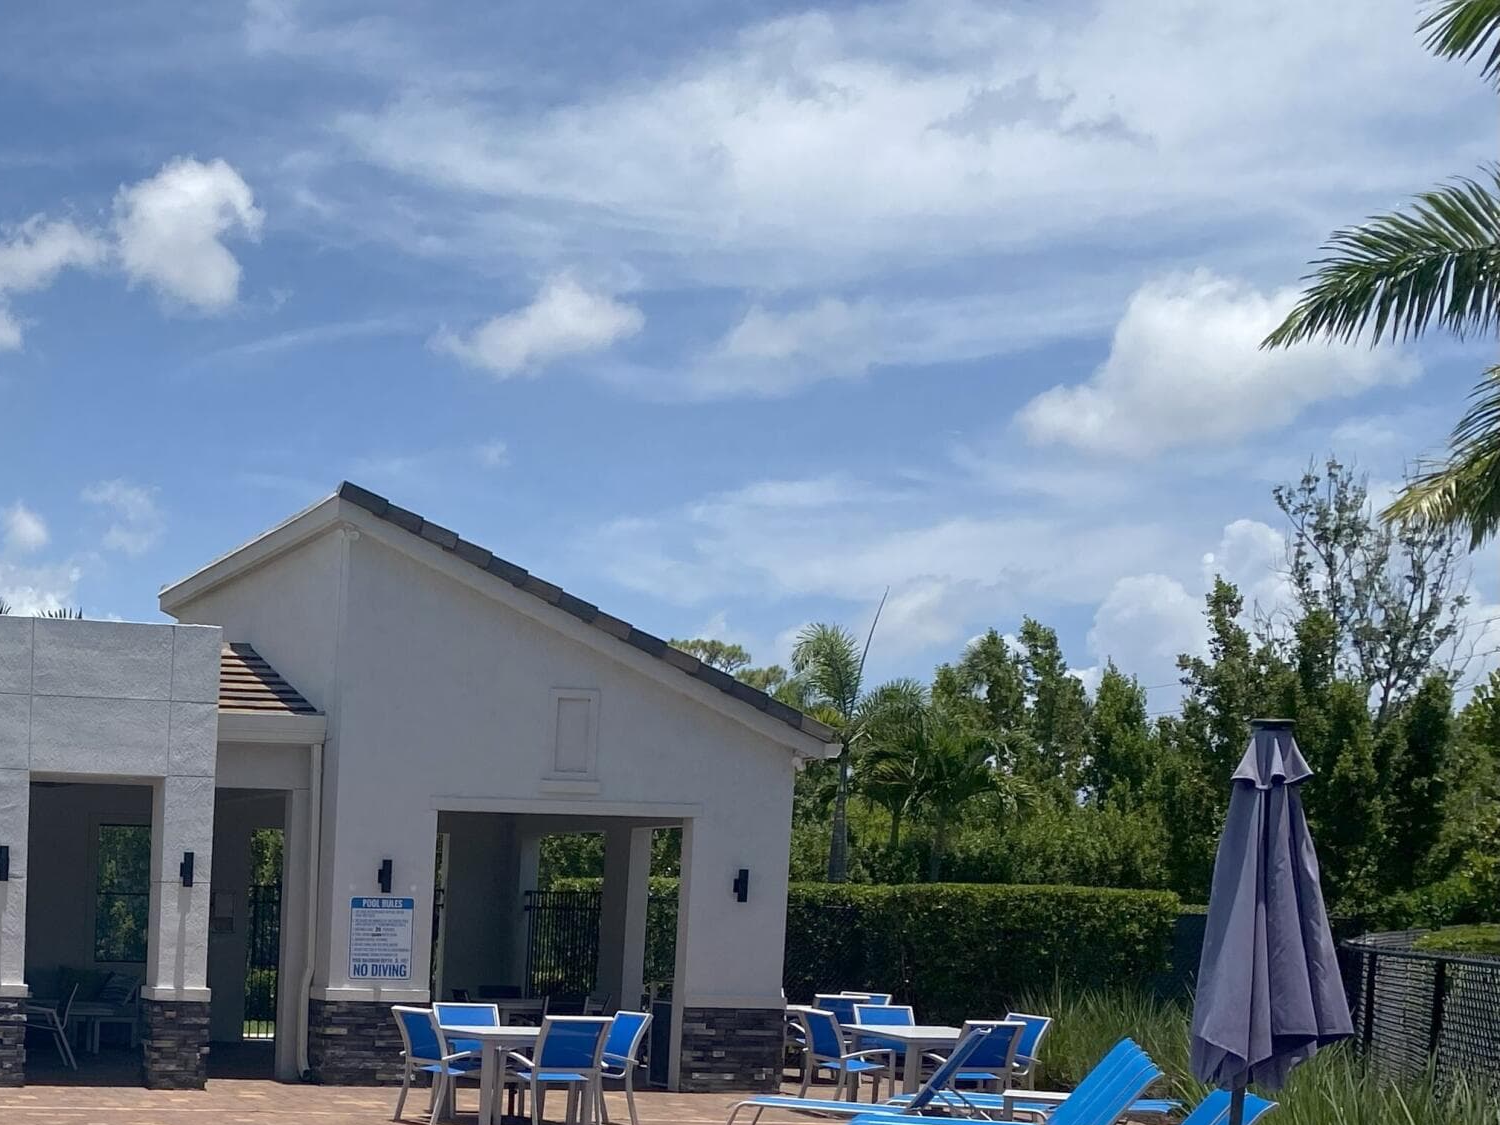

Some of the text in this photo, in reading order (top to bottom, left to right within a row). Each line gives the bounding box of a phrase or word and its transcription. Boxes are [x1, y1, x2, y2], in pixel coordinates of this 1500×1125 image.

[362, 899, 380, 908] POOL
[353, 963, 407, 977] NO DIVING
